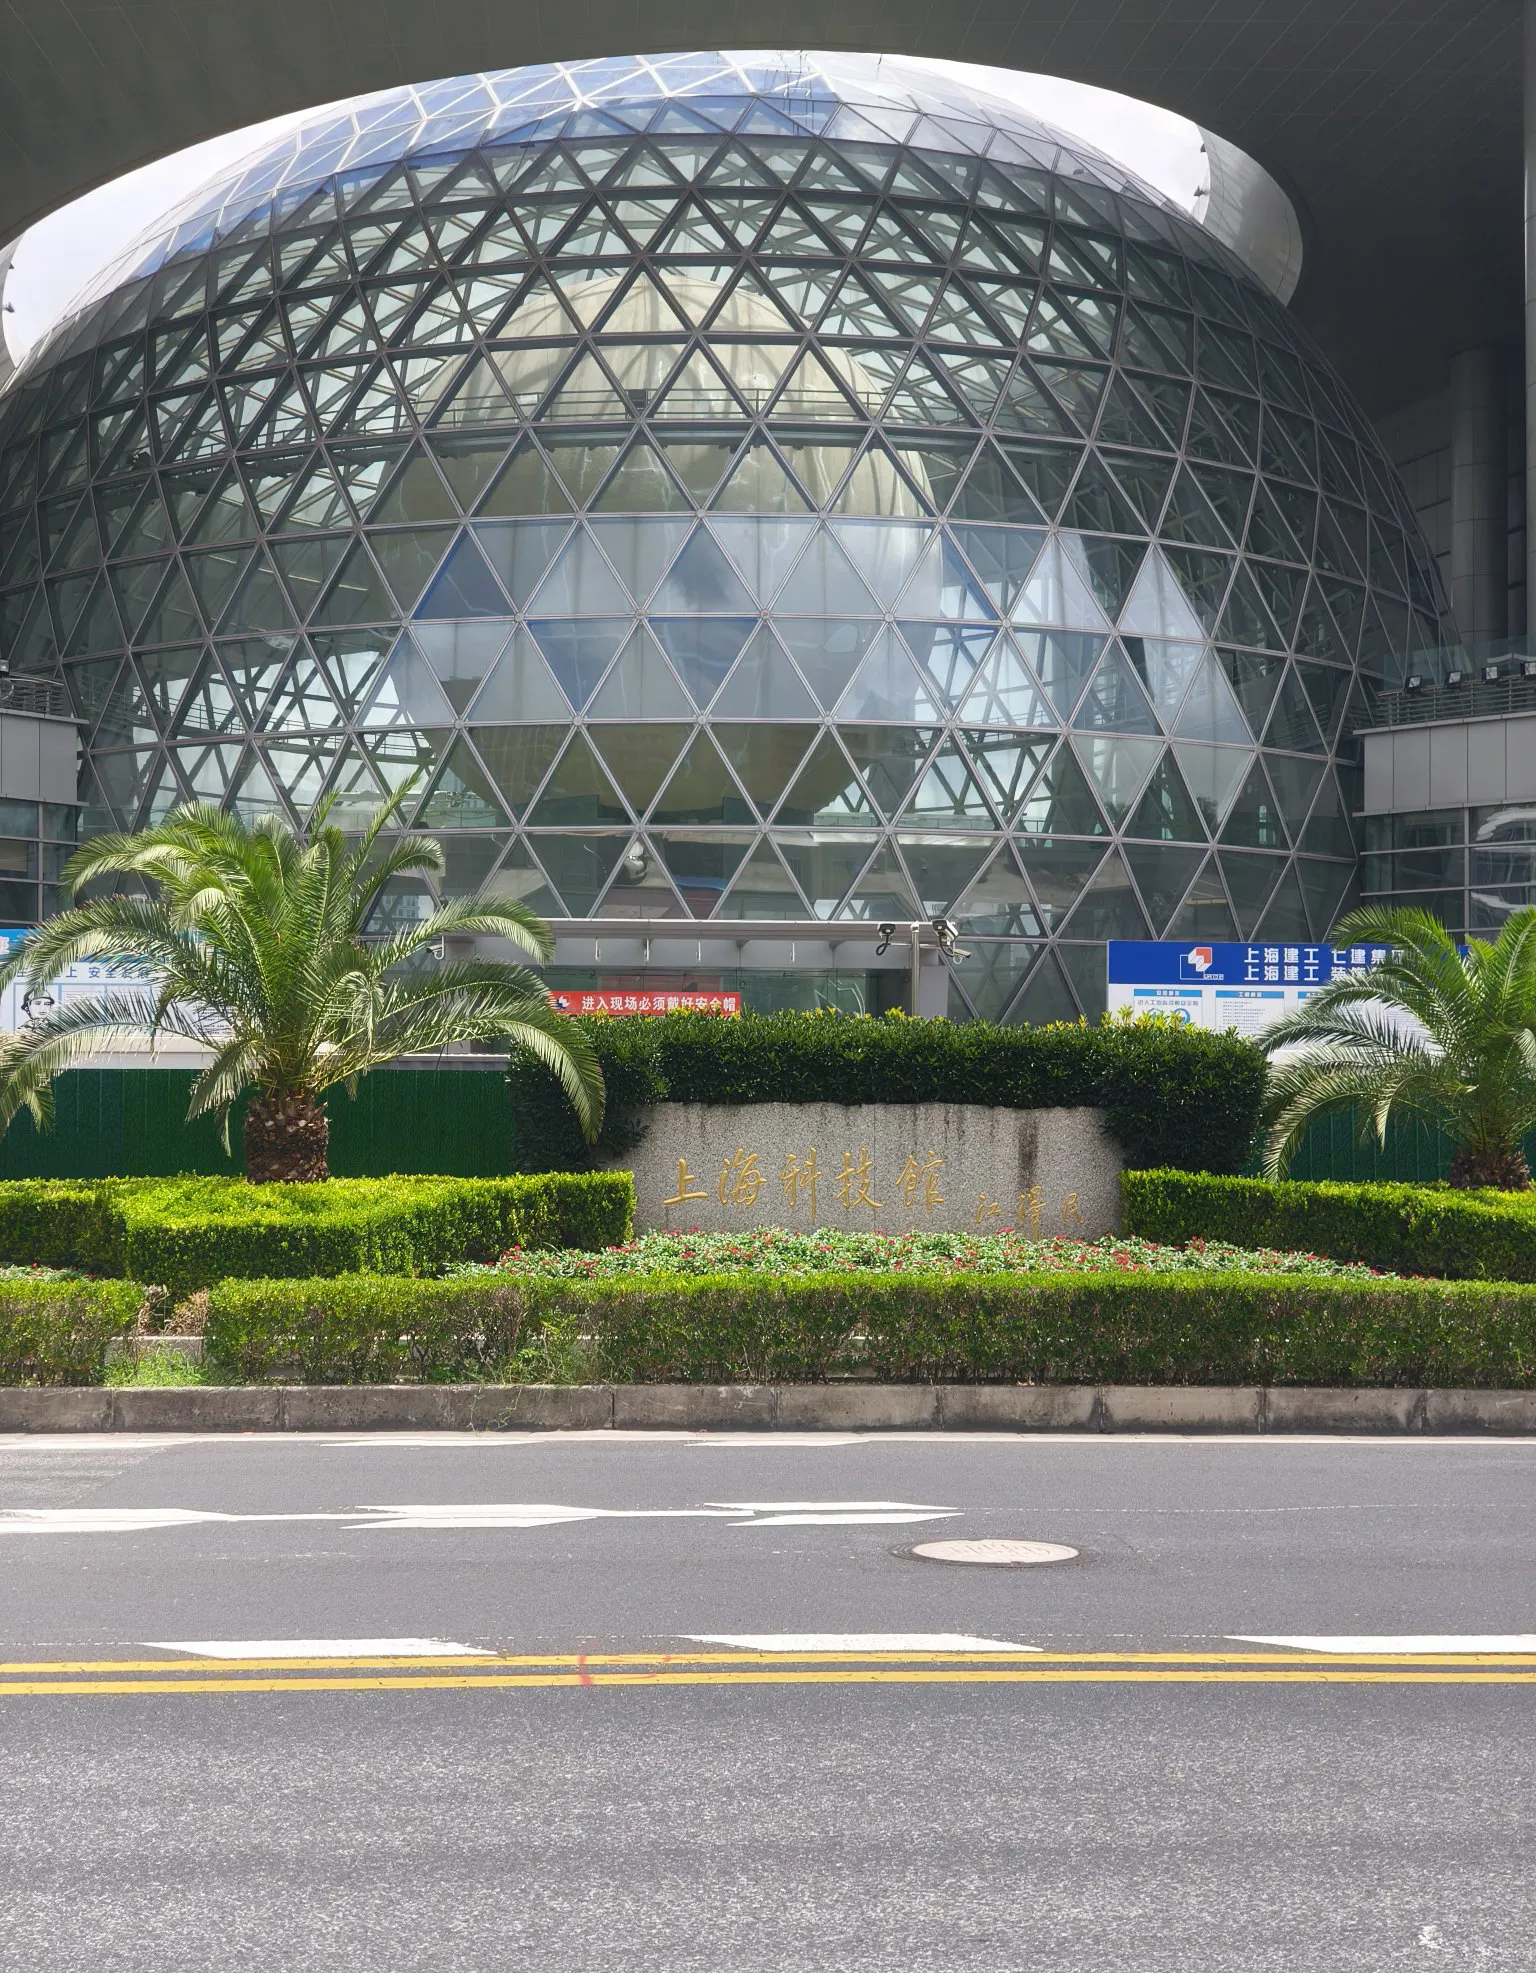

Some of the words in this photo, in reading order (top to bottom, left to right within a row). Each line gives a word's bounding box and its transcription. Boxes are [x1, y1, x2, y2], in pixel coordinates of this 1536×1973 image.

[1244, 947, 1319, 964] 上海建工
[1244, 965, 1319, 981] 上海建工
[582, 996, 736, 1012] 进入现场必须戴好安全帽
